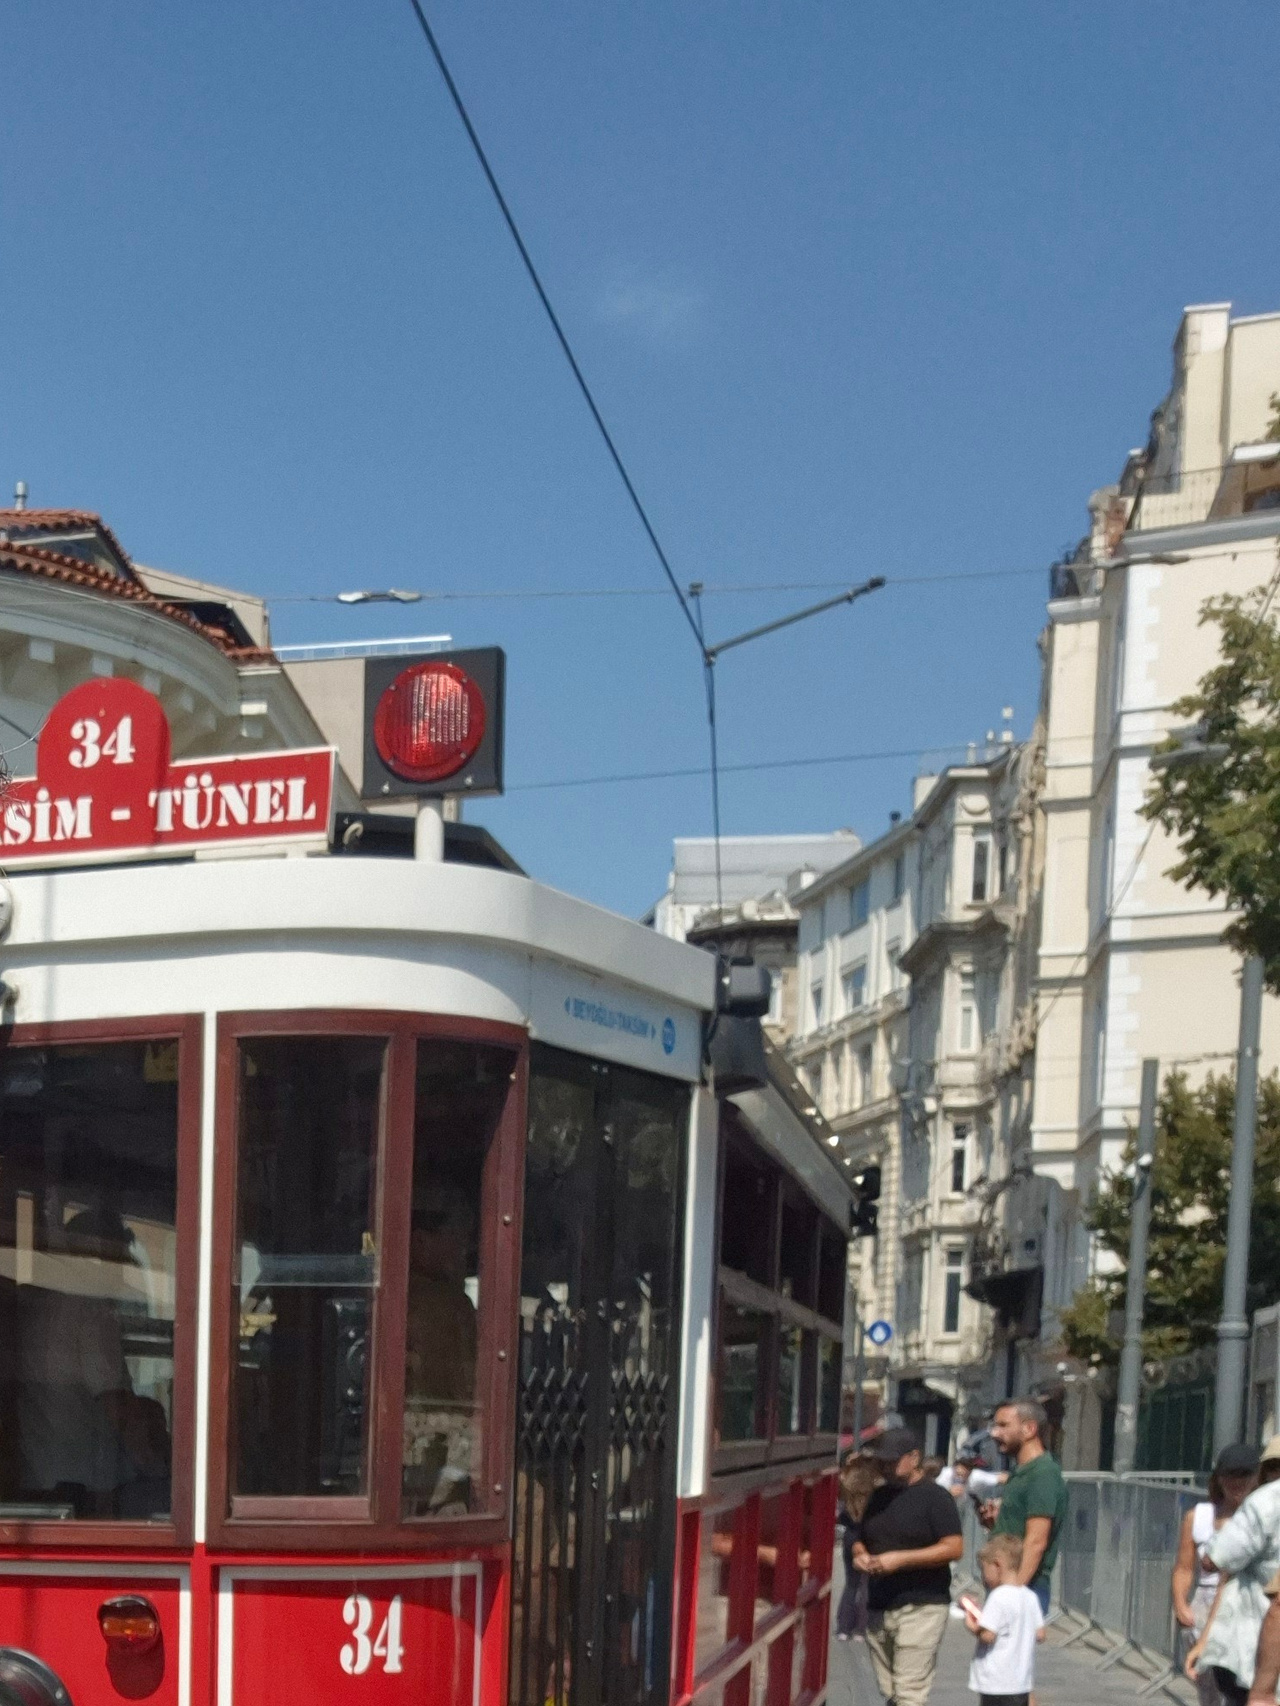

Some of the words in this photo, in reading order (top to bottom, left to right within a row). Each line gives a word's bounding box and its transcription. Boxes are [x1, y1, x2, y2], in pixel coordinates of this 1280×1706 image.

[69, 715, 135, 768] 34
[148, 772, 317, 832] TÜNEL
[340, 1594, 404, 1674] 34
